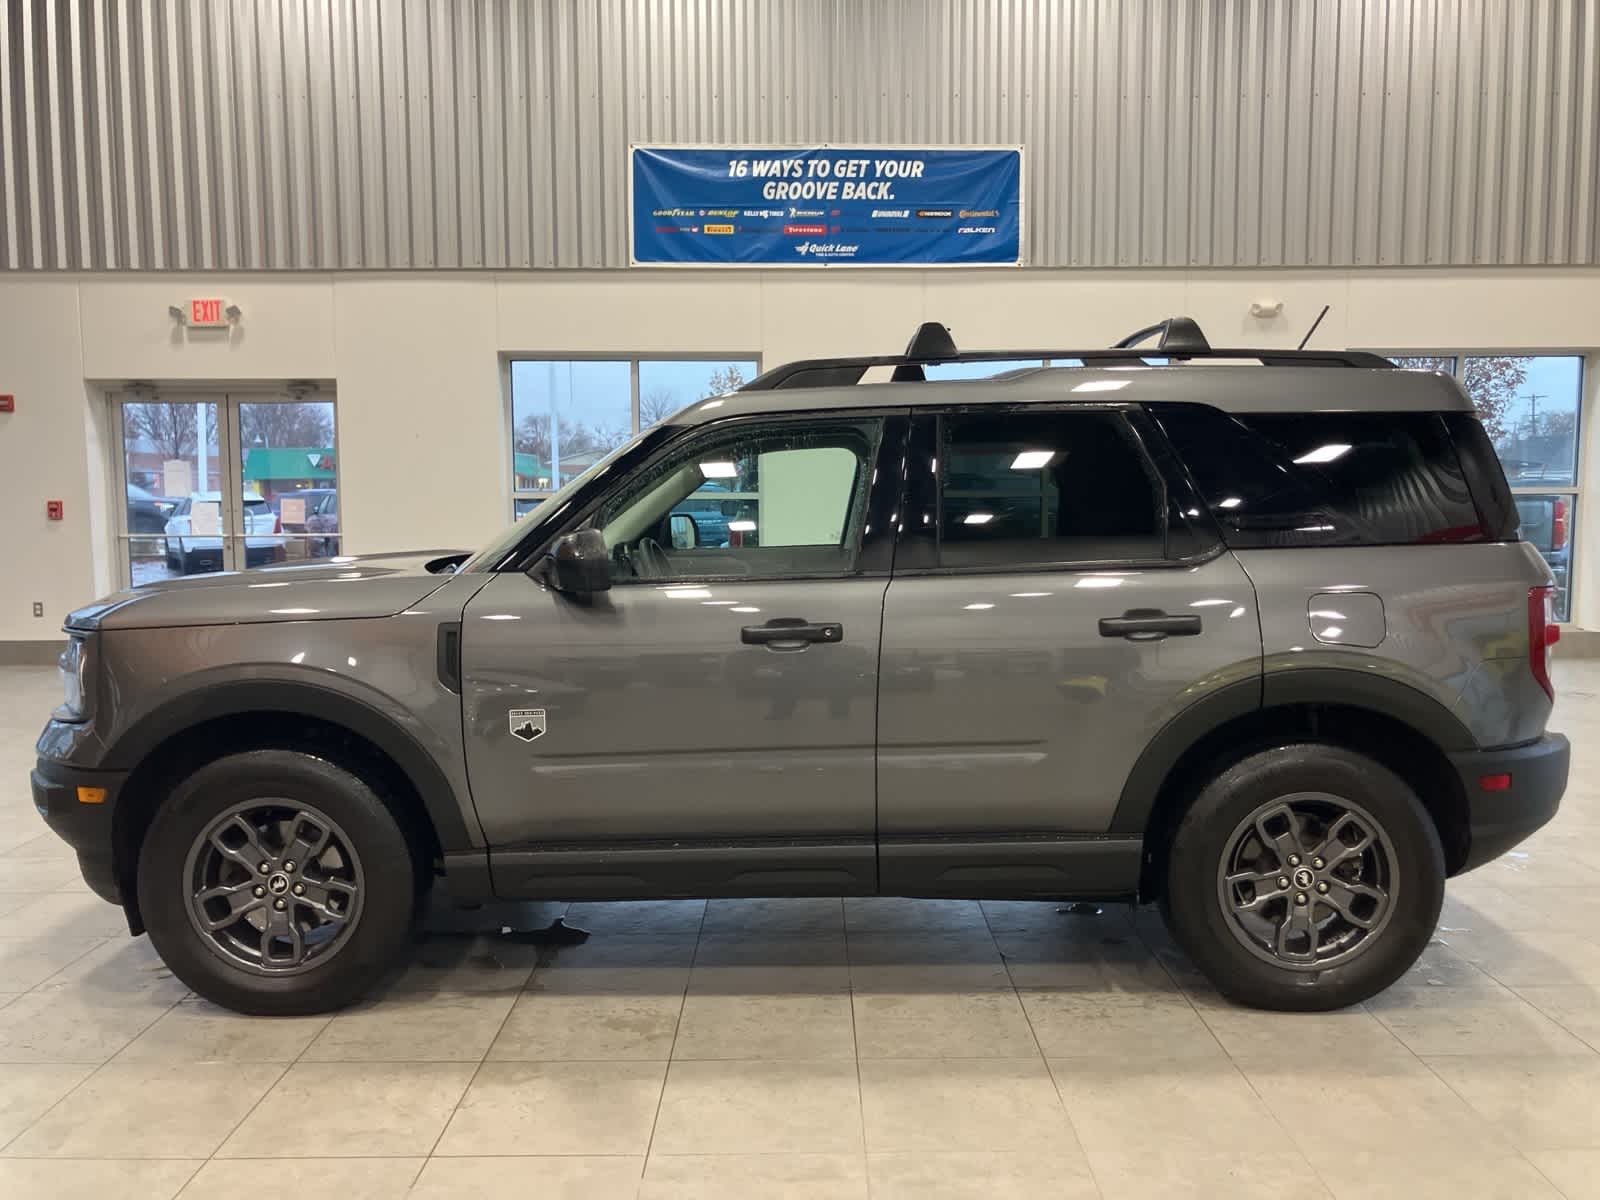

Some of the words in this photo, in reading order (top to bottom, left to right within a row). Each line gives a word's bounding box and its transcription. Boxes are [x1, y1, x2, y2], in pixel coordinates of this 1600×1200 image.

[728, 160, 746, 178] 16
[751, 160, 804, 178] WAYS
[807, 160, 830, 178] TO
[833, 160, 870, 178] GET
[874, 160, 924, 178] YOUR
[762, 181, 840, 200] GROOVE
[842, 181, 895, 200] BACK.
[809, 243, 835, 253] Quick
[835, 243, 859, 253] Lane
[193, 300, 221, 322] EXIT
